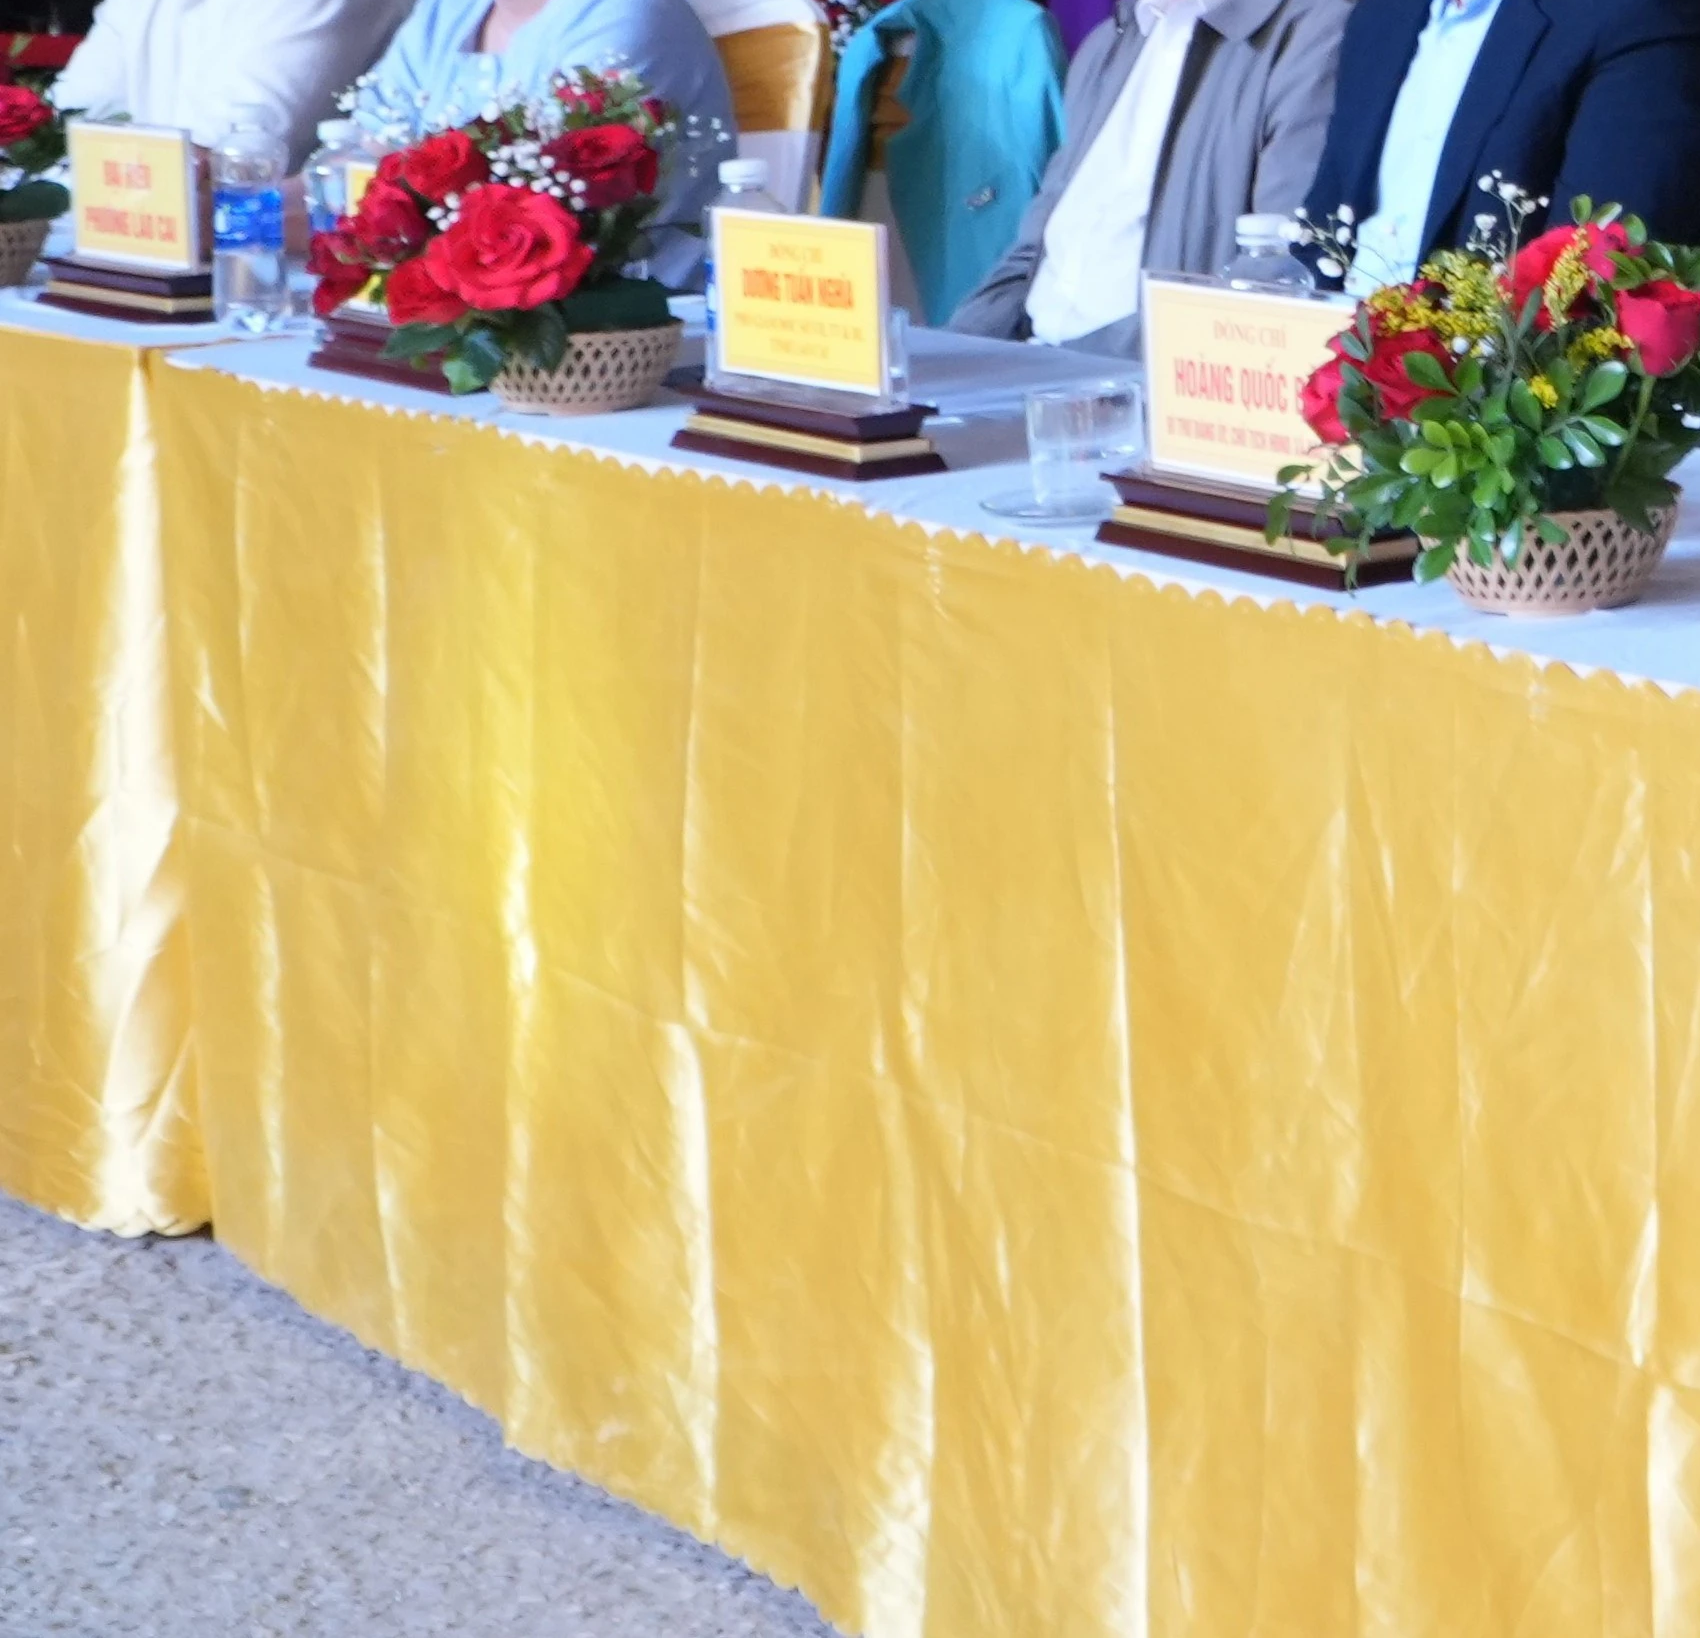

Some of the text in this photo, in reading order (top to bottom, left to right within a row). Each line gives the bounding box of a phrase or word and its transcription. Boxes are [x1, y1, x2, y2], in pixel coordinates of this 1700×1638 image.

[1213, 319, 1287, 349] ĐỒNG CHÍ
[1174, 353, 1235, 406] HOÀNG
[1240, 356, 1288, 414] QUỐC
